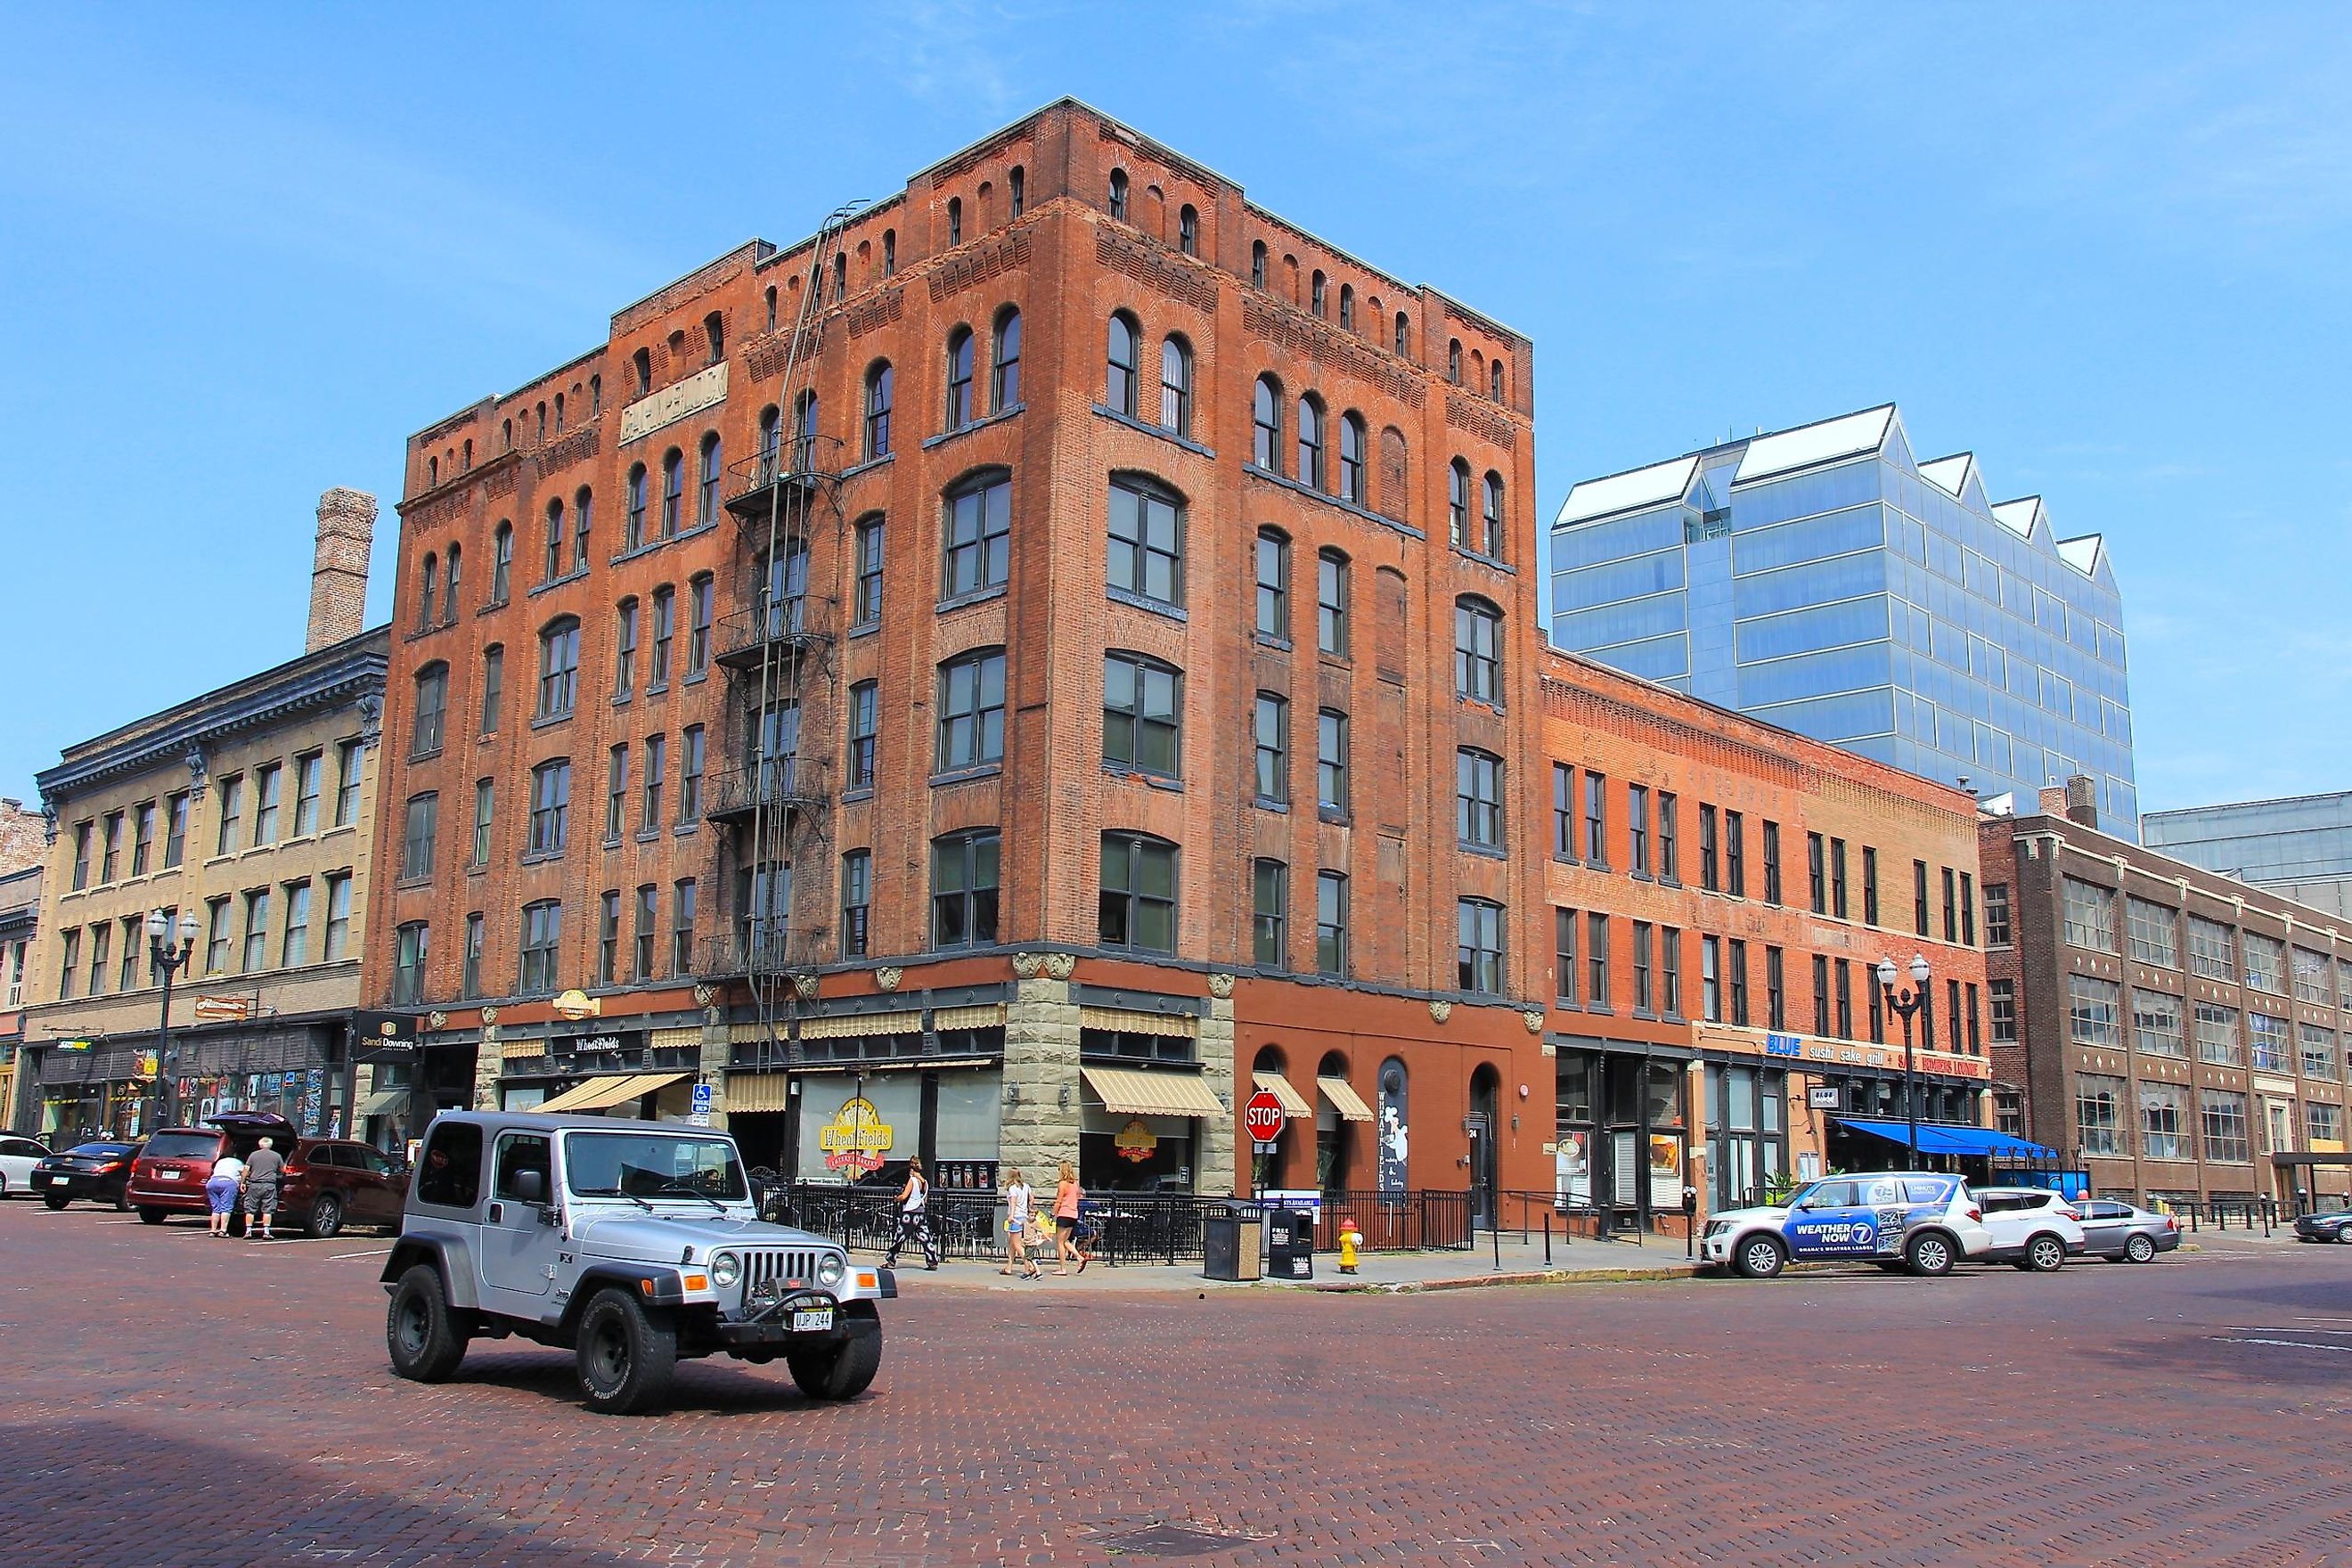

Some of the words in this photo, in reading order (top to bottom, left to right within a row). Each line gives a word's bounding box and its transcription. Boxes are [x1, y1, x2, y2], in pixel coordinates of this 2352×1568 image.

[362, 1036, 383, 1047] Sandi
[383, 1037, 413, 1050] Downing
[1768, 1033, 1801, 1057] BLUE
[1809, 1045, 1834, 1059] sushi
[1839, 1049, 1861, 1063] sake
[1866, 1051, 1883, 1067] grill
[1248, 1107, 1280, 1126] STOP
[825, 1129, 855, 1147] Wheat
[857, 1129, 888, 1146] Fields
[1469, 1129, 1477, 1139] 24
[1796, 1223, 1851, 1235] WEATHER
[1821, 1233, 1850, 1243] NOW
[796, 1314, 811, 1327] UJP
[815, 1313, 829, 1326] 244
